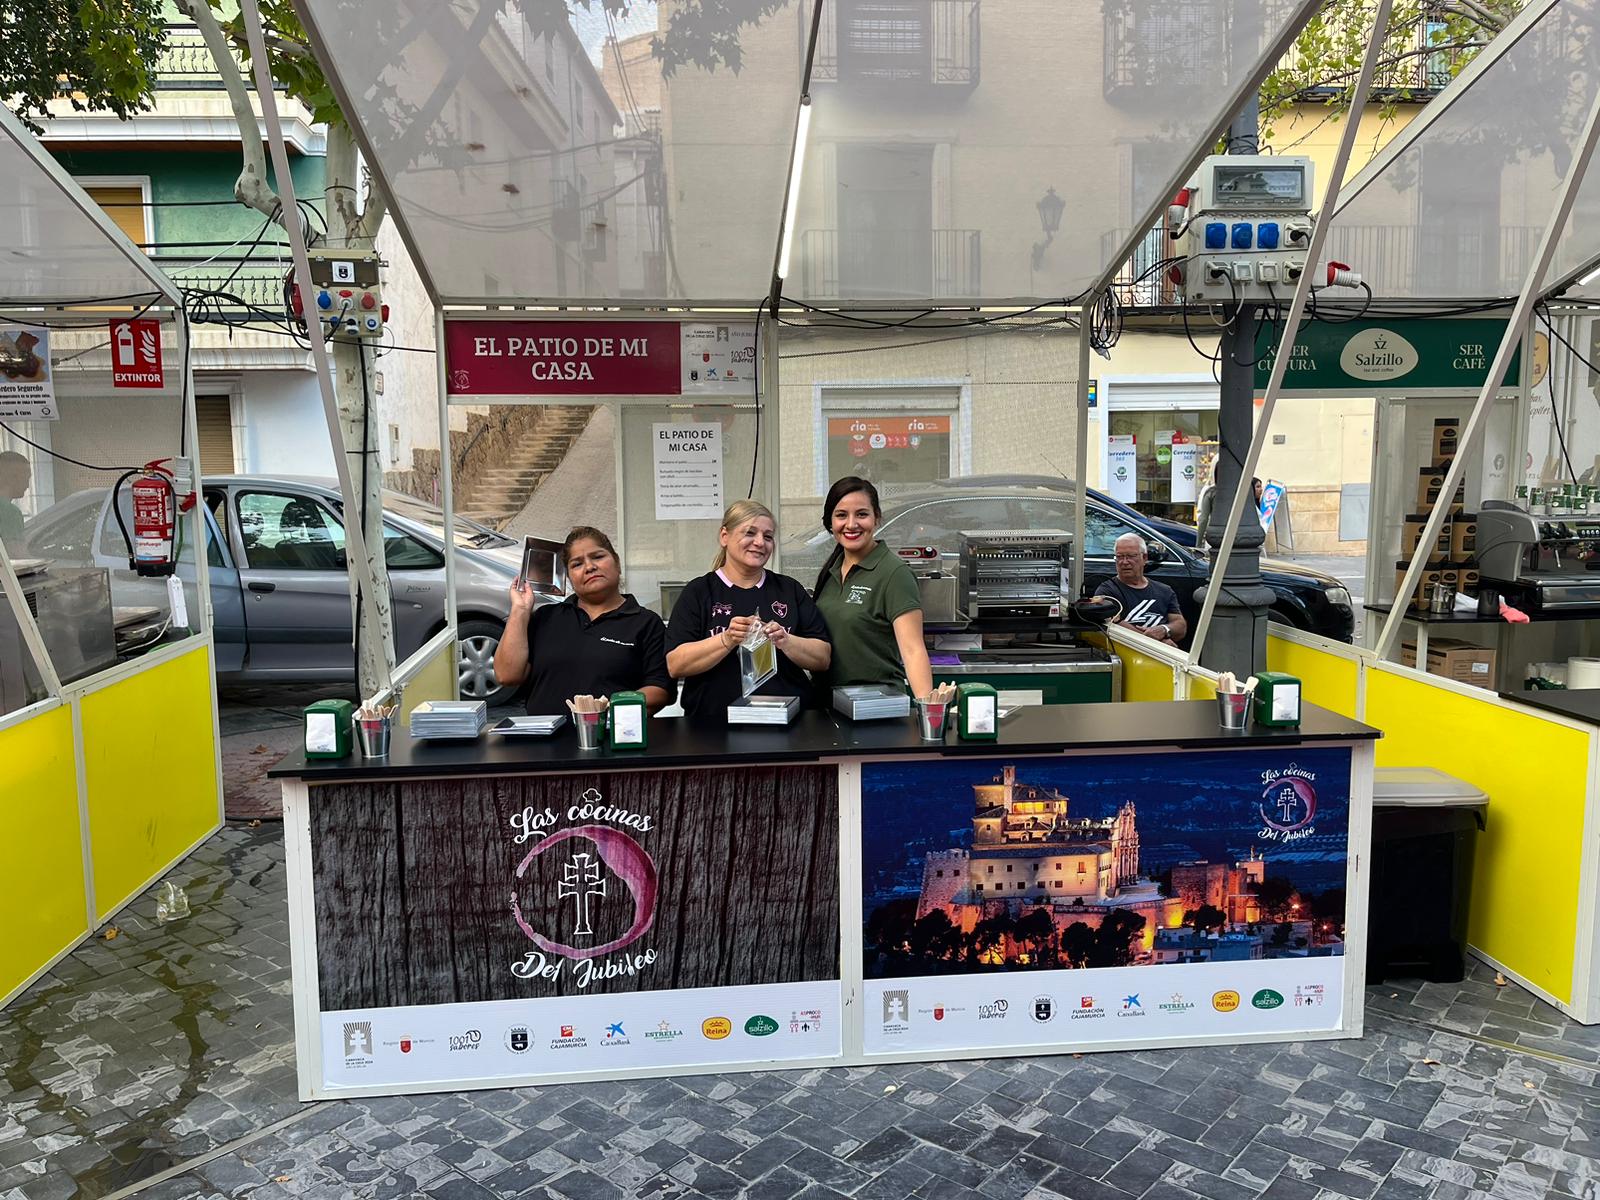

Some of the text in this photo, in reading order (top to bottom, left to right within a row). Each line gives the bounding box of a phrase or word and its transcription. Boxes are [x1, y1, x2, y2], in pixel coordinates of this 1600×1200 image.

[474, 338, 648, 356] EL PATIO DE MI
[1460, 345, 1483, 355] SER
[1356, 353, 1403, 366] Salzillo
[1453, 356, 1486, 369] CAFÉ
[532, 362, 594, 380] CASA
[115, 373, 160, 382] EXTINTOR
[851, 421, 866, 431] ria
[908, 419, 924, 430] ria
[660, 430, 713, 439] EL PATIO DE
[682, 443, 707, 451] CASA
[1261, 768, 1316, 785] Las cocinas
[510, 804, 654, 844] Las cocinas
[1258, 827, 1315, 843] Del Jubileo
[511, 948, 659, 988] Del Jubileo
[978, 1005, 996, 1013] 1001
[749, 1023, 773, 1032] salzillo
[450, 1035, 469, 1045] 1001
[600, 1039, 630, 1047] CaixaBank
